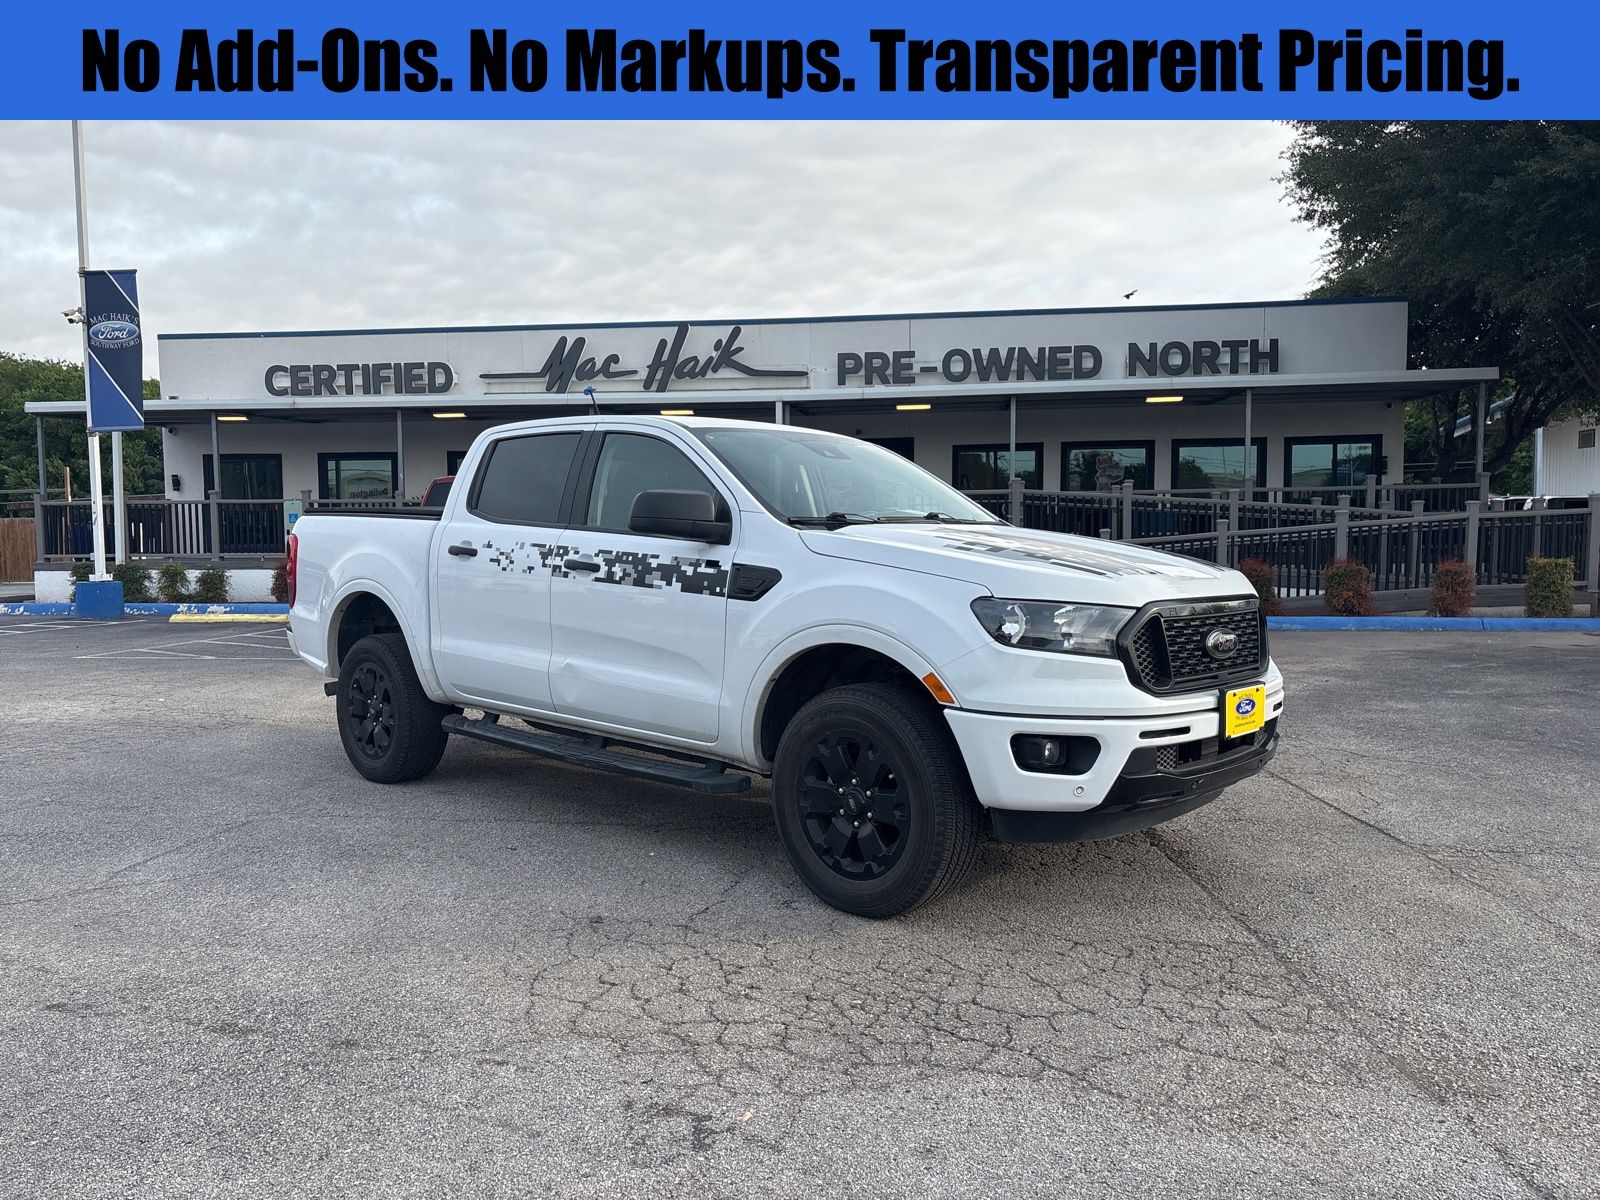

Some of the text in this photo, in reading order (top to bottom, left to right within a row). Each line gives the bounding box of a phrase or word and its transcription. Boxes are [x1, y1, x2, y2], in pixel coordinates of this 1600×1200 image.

[89, 312, 139, 325] MAC HAIK'S
[90, 337, 140, 350] SOUTHWAY FORD
[98, 324, 129, 339] Ford
[643, 322, 808, 393] Haik
[837, 338, 1280, 386] PRE-OWNED NORTH
[264, 361, 455, 397] CERTIFIED
